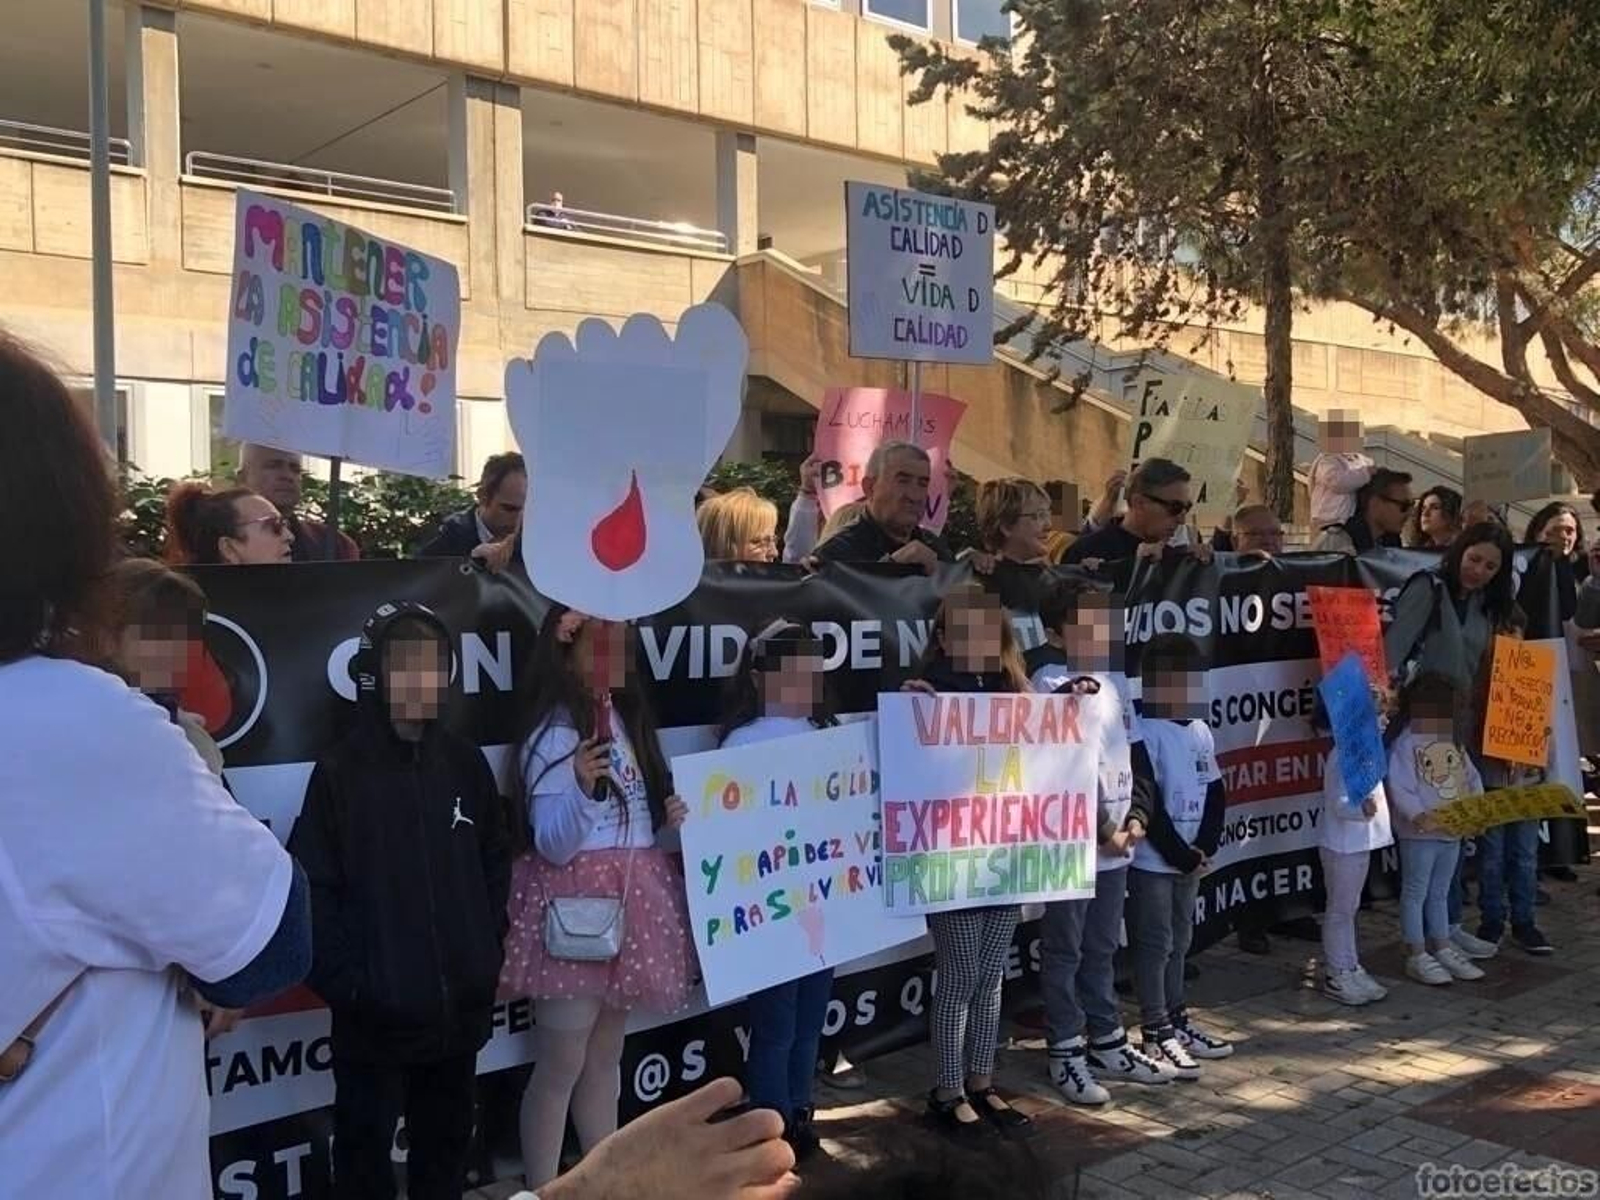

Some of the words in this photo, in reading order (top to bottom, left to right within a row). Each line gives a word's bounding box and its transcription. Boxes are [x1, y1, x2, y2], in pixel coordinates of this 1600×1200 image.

[862, 189, 968, 232] ASISTENCIA
[977, 211, 988, 234] D
[245, 205, 430, 312] MANTENER
[890, 226, 963, 259] CALIDAD
[902, 276, 955, 310] VIDA
[968, 287, 980, 312] D
[234, 270, 265, 327] LA
[277, 282, 449, 372] ASISTENCIA
[893, 315, 968, 349] CALIDAD
[1221, 594, 1264, 635] NO
[639, 624, 749, 680] VID
[911, 696, 1083, 745] VALORAR
[1226, 679, 1314, 726] CONGÉ
[976, 745, 1024, 793] LA
[1276, 755, 1310, 782] EN
[770, 780, 798, 807] LA
[884, 790, 1090, 853] EXPERIENCIA
[1217, 811, 1303, 848] GNÓSTICO
[1308, 808, 1319, 828] Y
[701, 854, 724, 894] Y
[855, 812, 882, 856] VI
[866, 855, 882, 888] VI
[884, 843, 1095, 907] PROFESIONAL
[1215, 864, 1313, 913] NACER
[822, 990, 876, 1037] OS
